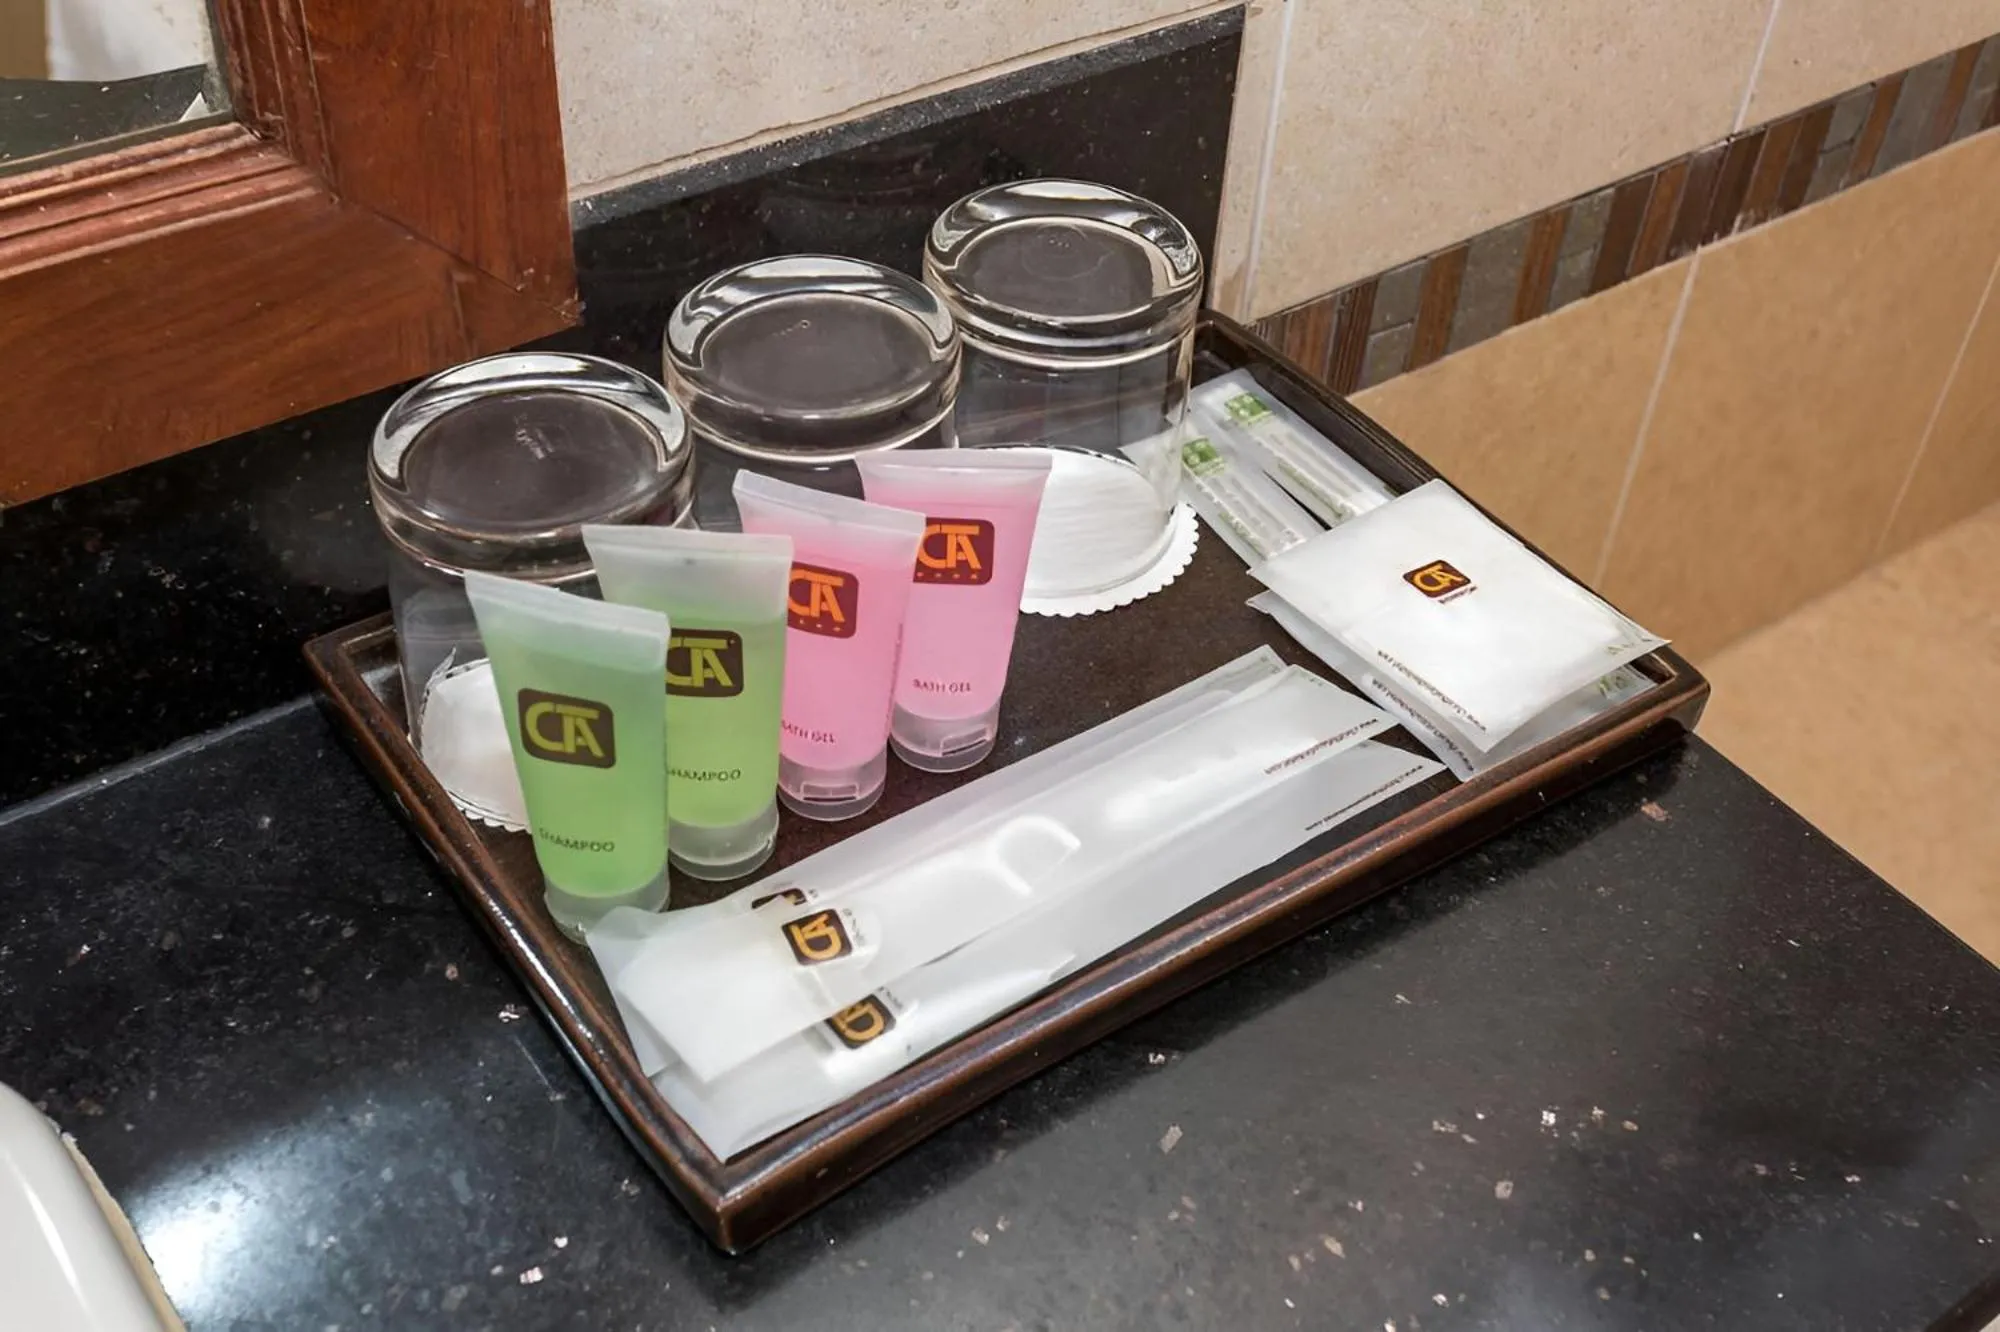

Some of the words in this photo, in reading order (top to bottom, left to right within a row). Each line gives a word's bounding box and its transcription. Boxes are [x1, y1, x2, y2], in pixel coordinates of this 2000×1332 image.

[913, 678, 946, 693] BATH
[949, 682, 972, 693] GEL
[539, 827, 615, 853] SHAMPOO
